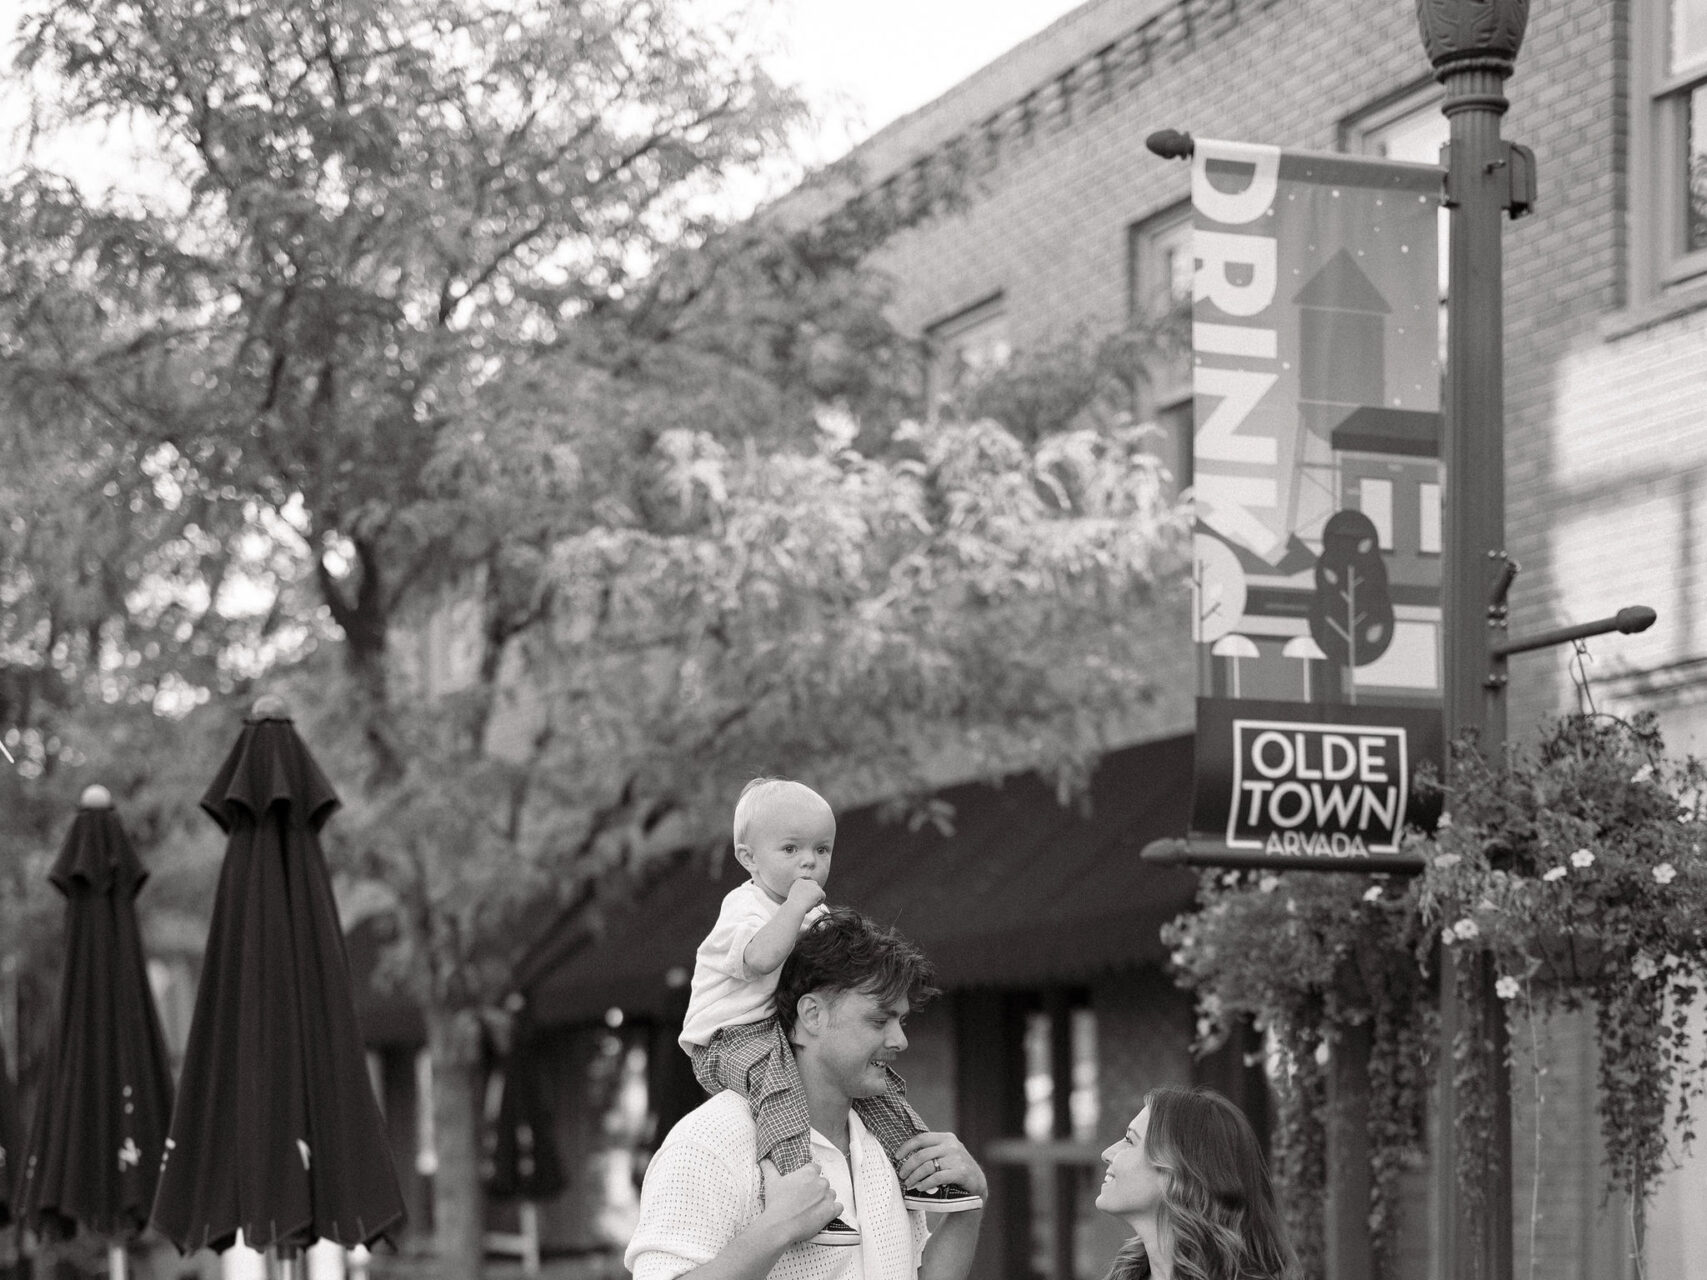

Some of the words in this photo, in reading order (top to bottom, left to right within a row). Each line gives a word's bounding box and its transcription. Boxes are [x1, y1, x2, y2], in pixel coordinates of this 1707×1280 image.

[1191, 138, 1281, 557] DRINK
[1251, 731, 1388, 782] OLDE
[1242, 781, 1397, 831] TOWN
[1265, 830, 1370, 858] ARVADA
